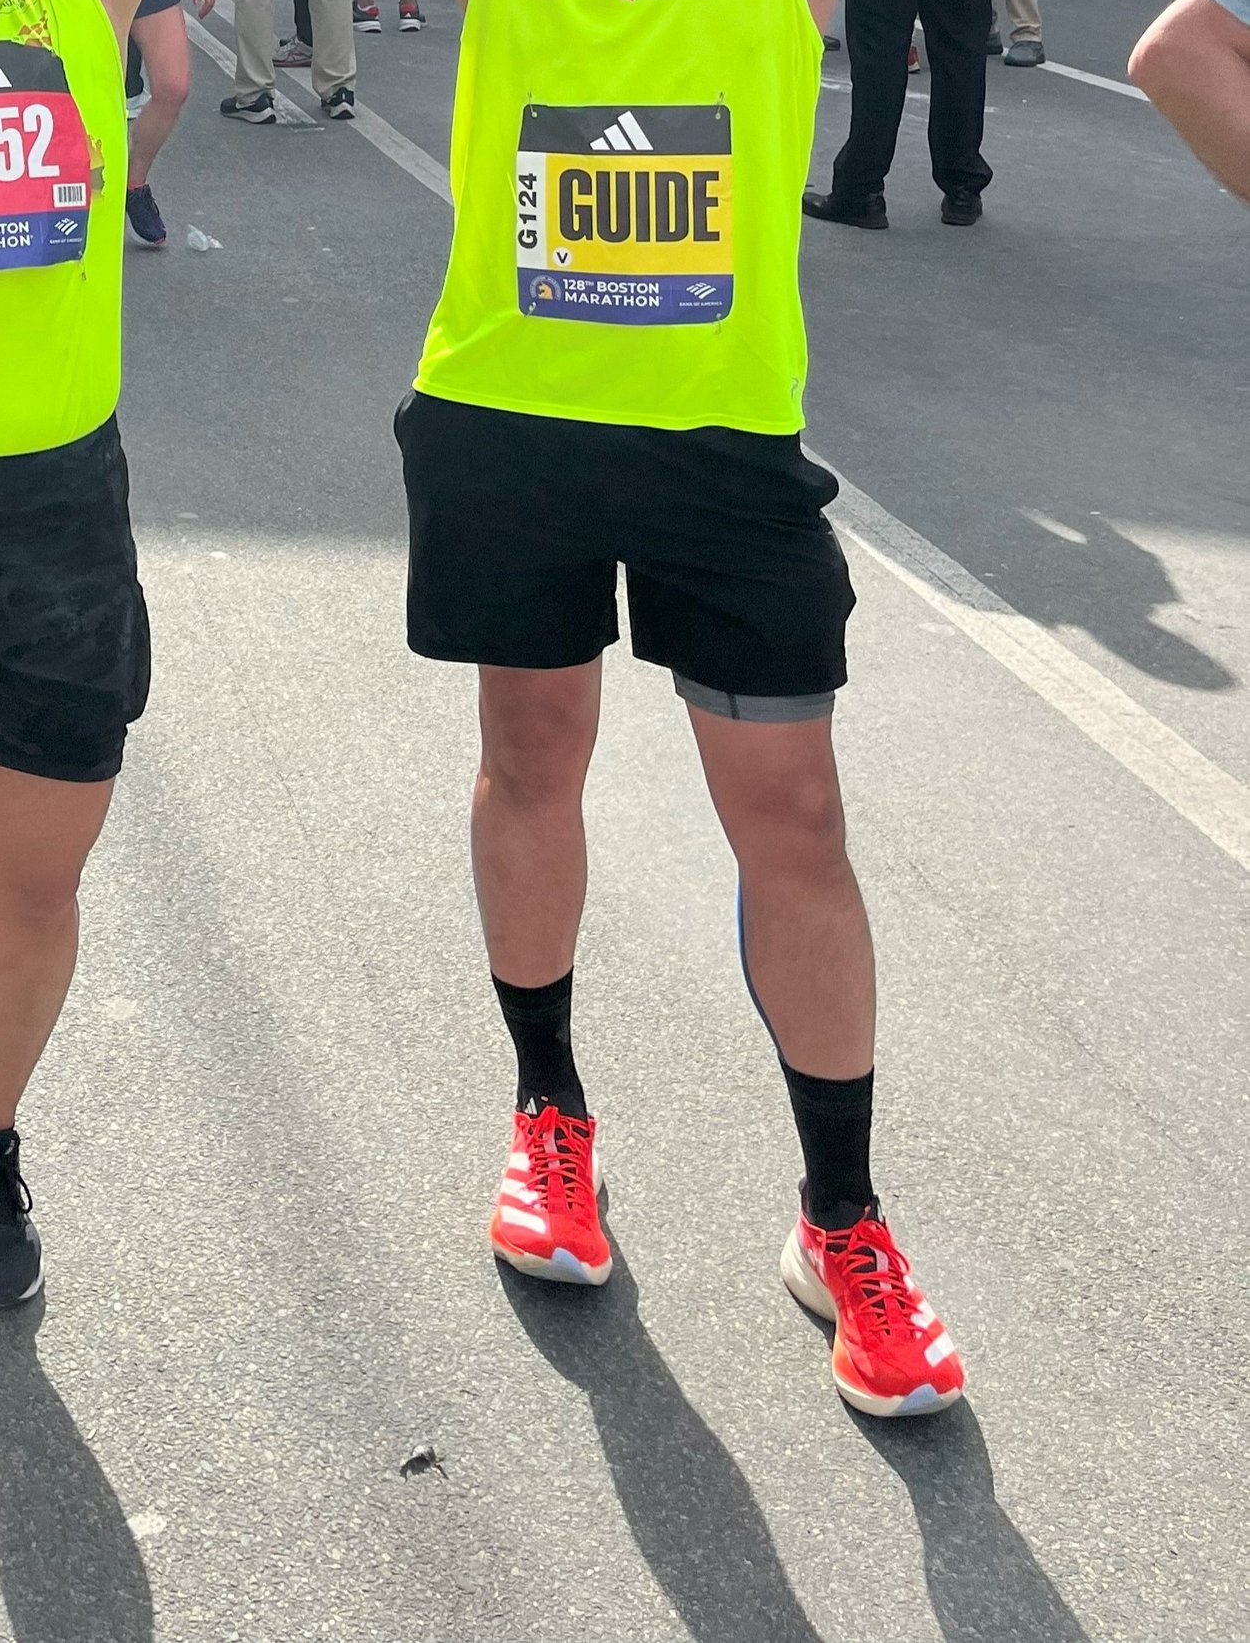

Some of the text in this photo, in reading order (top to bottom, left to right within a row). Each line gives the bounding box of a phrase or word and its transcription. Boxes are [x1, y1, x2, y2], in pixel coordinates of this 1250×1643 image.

[518, 172, 538, 249] G124
[558, 168, 721, 244] GUIDE
[556, 251, 568, 264] V
[562, 278, 595, 292] 128TH
[597, 281, 660, 294] BOSTON
[564, 291, 661, 307] MARATHON
